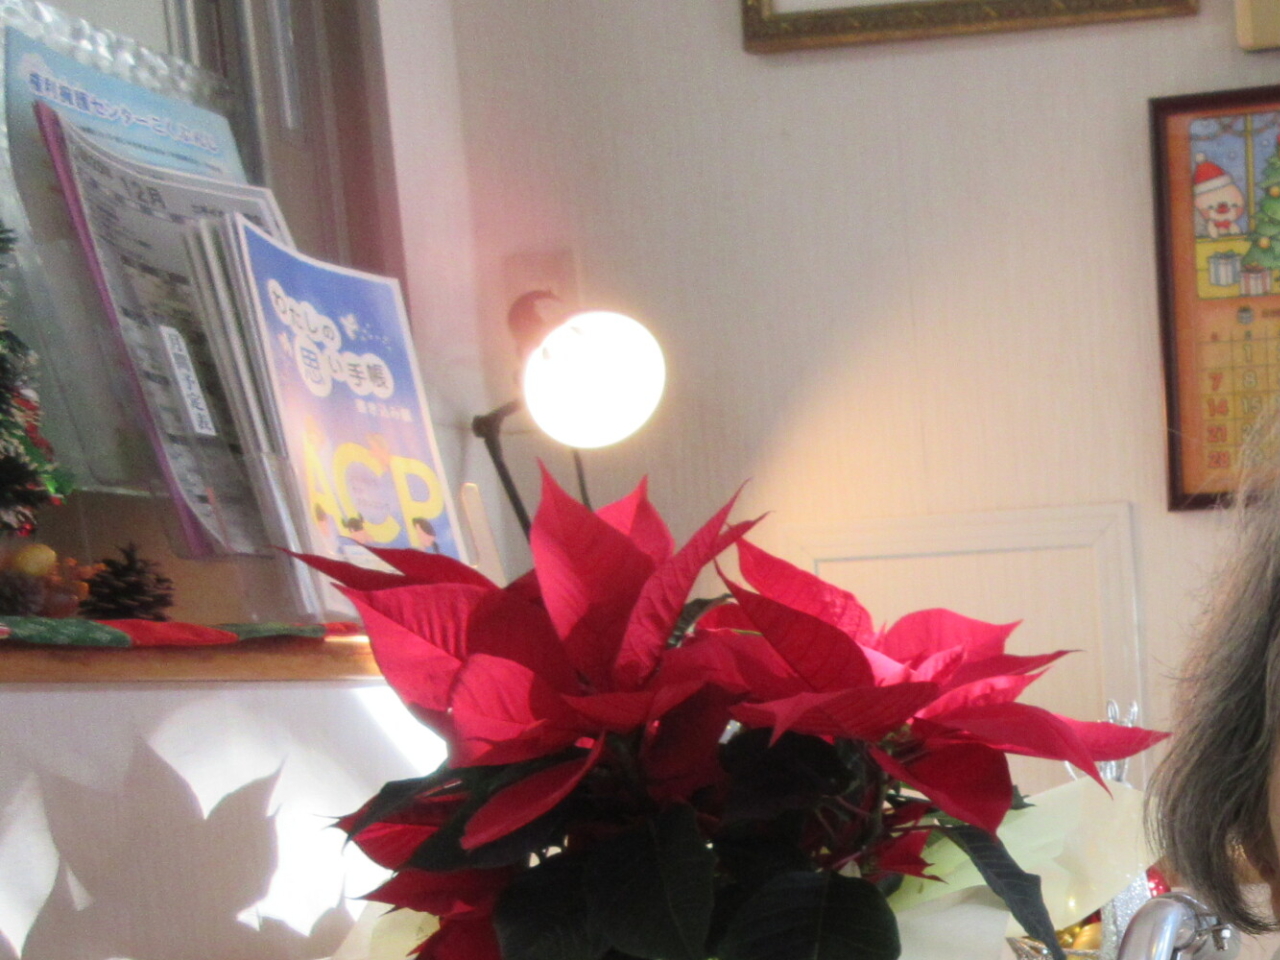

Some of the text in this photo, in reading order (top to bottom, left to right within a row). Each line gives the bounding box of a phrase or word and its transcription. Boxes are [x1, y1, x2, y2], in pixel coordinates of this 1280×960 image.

[271, 289, 336, 341] わたしの
[300, 345, 390, 389] 思い手帳
[304, 430, 444, 547] ACP
